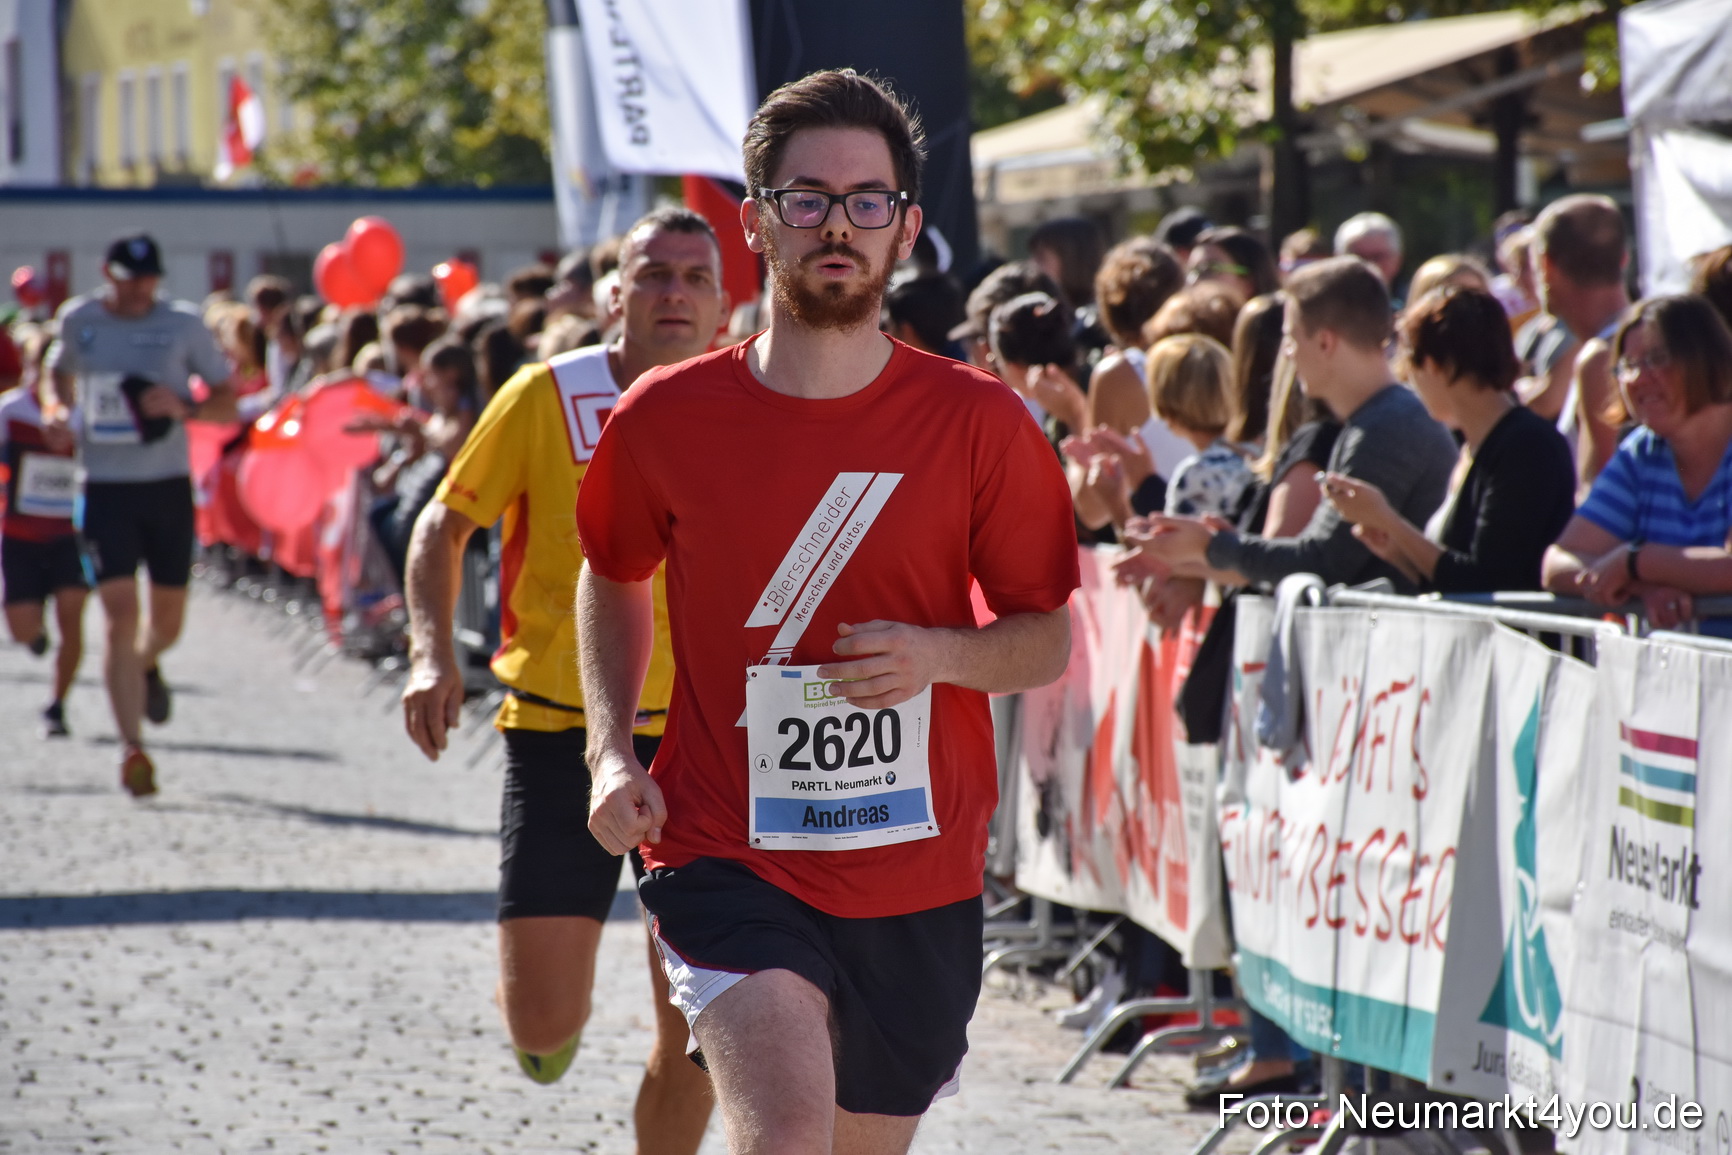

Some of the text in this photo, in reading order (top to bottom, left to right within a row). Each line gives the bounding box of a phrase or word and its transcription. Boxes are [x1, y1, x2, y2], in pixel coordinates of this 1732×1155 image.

[794, 520, 867, 623] Menschen und Autos.
[804, 700, 829, 709] inspired
[777, 708, 902, 772] 2620
[760, 758, 768, 769] A
[791, 775, 883, 792] PARTL Neumarkt
[802, 804, 890, 828] Andreas
